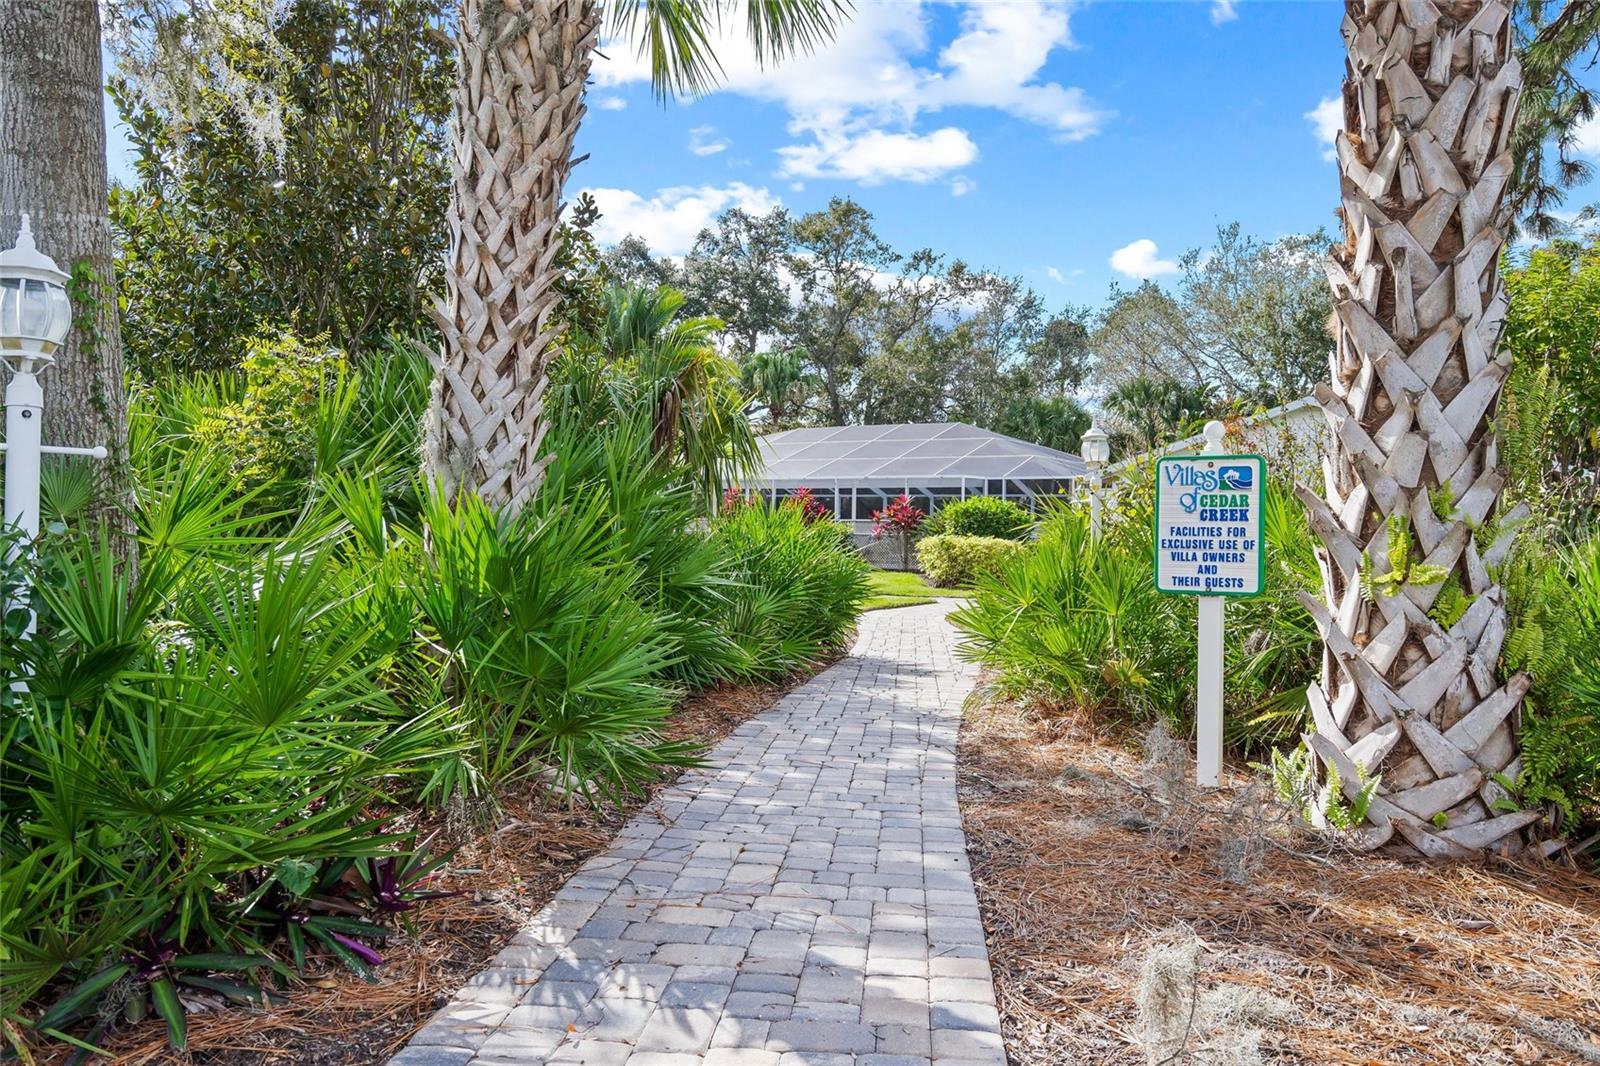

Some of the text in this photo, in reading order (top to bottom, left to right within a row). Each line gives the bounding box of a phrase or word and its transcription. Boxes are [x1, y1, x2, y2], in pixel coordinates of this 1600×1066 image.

[1165, 464, 1218, 492] Villas
[1180, 487, 1249, 513] of CEDAR
[1200, 509, 1249, 521] CREEK
[1170, 527, 1246, 536] FACILITIES FOR
[1162, 539, 1255, 550] EXCLUSIVE USE OF
[1171, 552, 1245, 562] VILLA OWNERS
[1198, 565, 1218, 574] AND
[1172, 576, 1244, 588] THEIR GUESTS
